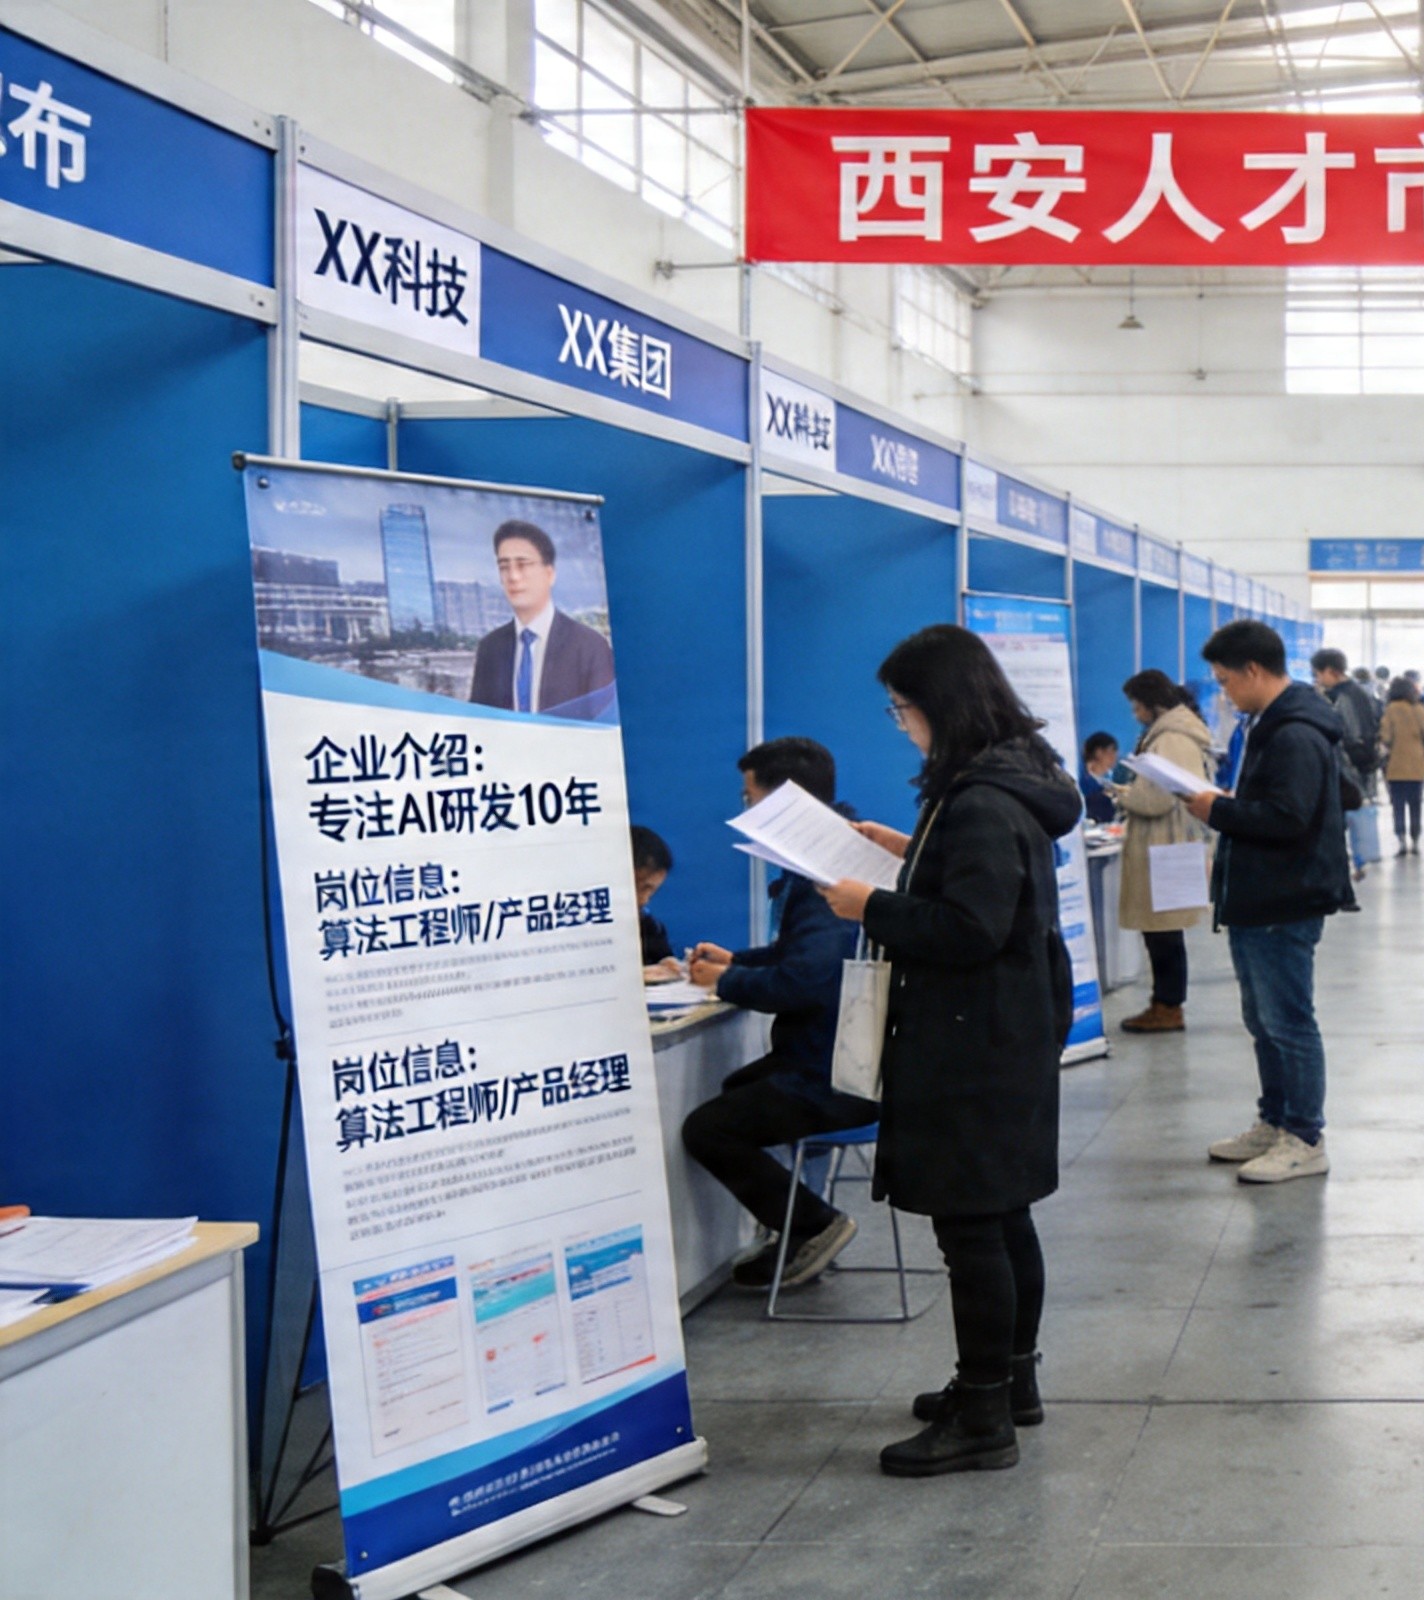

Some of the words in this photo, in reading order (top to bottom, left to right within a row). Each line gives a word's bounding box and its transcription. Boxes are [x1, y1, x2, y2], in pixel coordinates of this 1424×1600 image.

[0, 76, 92, 190] 布
[313, 207, 469, 327] XX科技
[557, 303, 672, 401] XX集团
[304, 732, 485, 785] 企业介绍：
[308, 776, 602, 842] 专注AI研发10年
[314, 862, 461, 913] 岗位信息：
[318, 887, 614, 961] 算法工程师/产品经理
[331, 1038, 478, 1102] 岗位信息：
[335, 1053, 632, 1153] 算法工程师/产品经理
